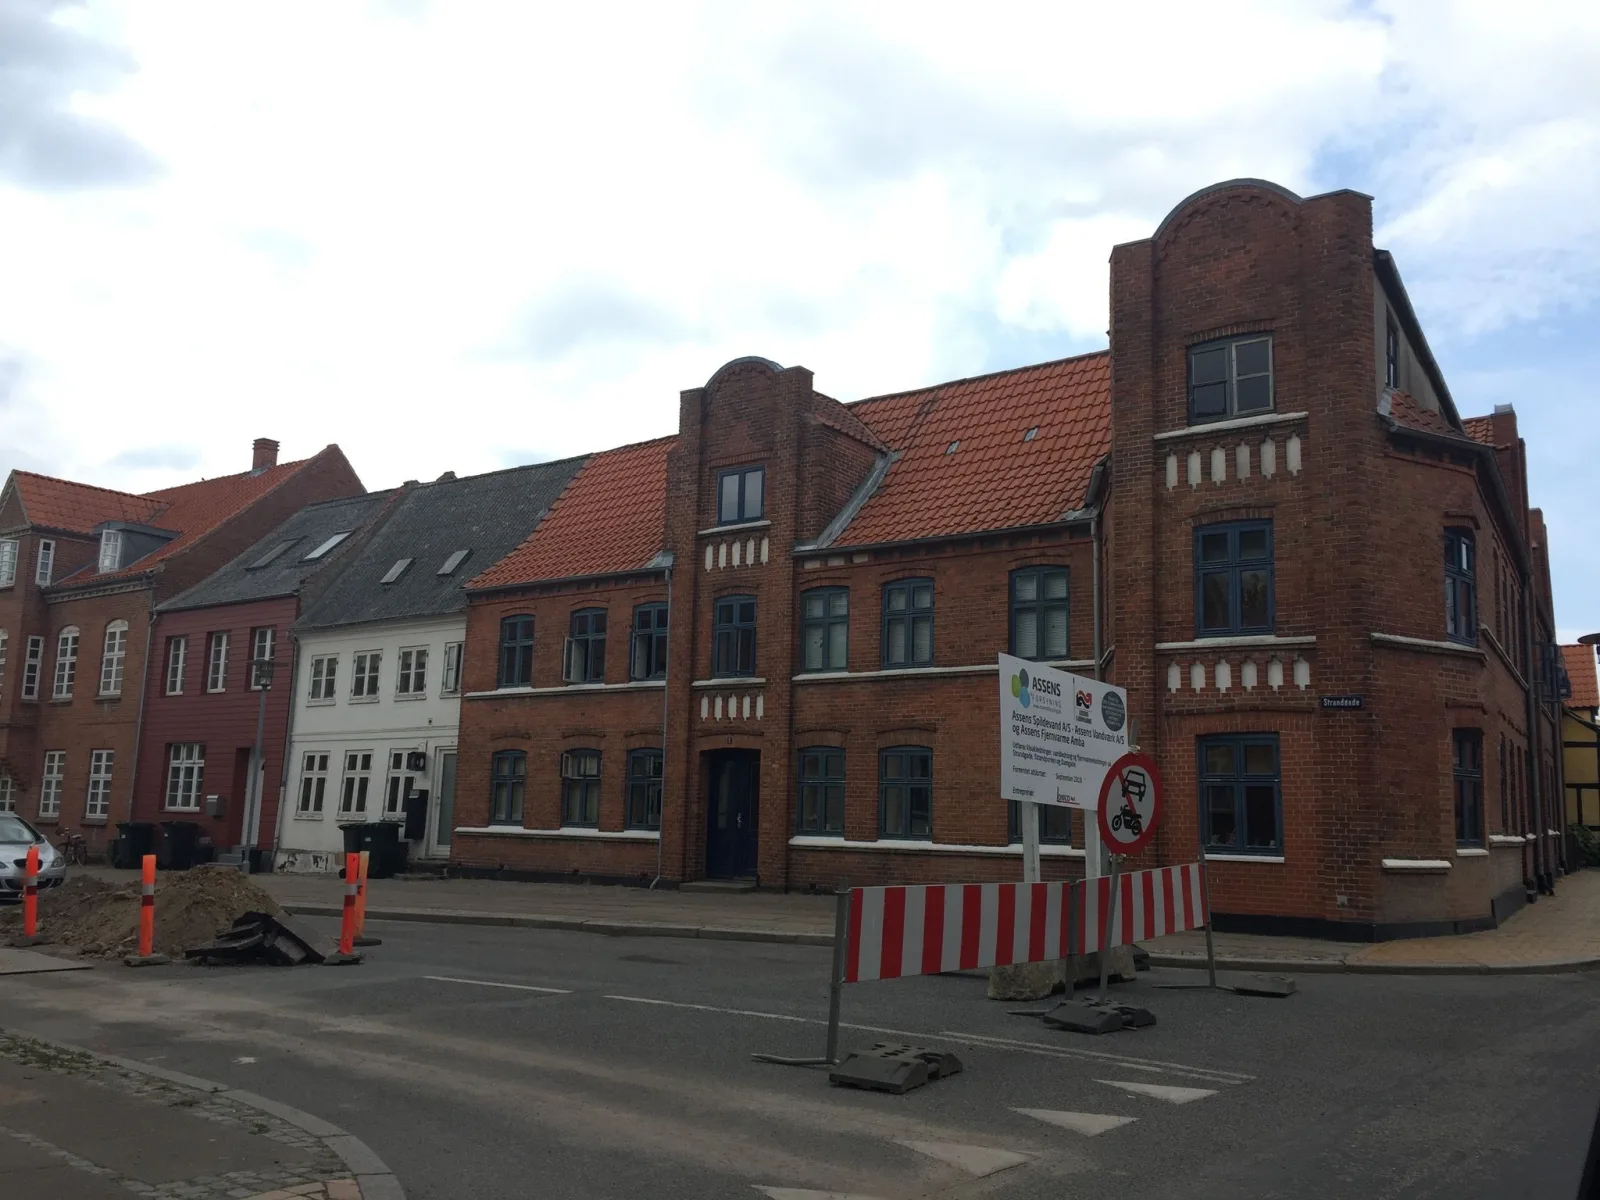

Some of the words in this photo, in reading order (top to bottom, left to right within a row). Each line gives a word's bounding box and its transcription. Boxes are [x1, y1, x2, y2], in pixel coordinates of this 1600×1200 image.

[1032, 676, 1061, 697] ASSENS
[1323, 697, 1360, 706] Strandgade
[1012, 710, 1031, 724] Assens
[1033, 715, 1061, 730] Spildevand
[1062, 721, 1071, 733] A/S
[1075, 725, 1092, 738] Assens
[1116, 734, 1124, 745] A/S
[1012, 724, 1019, 735] og
[1021, 724, 1040, 738] Assens
[1041, 728, 1070, 744] Fjernvarme
